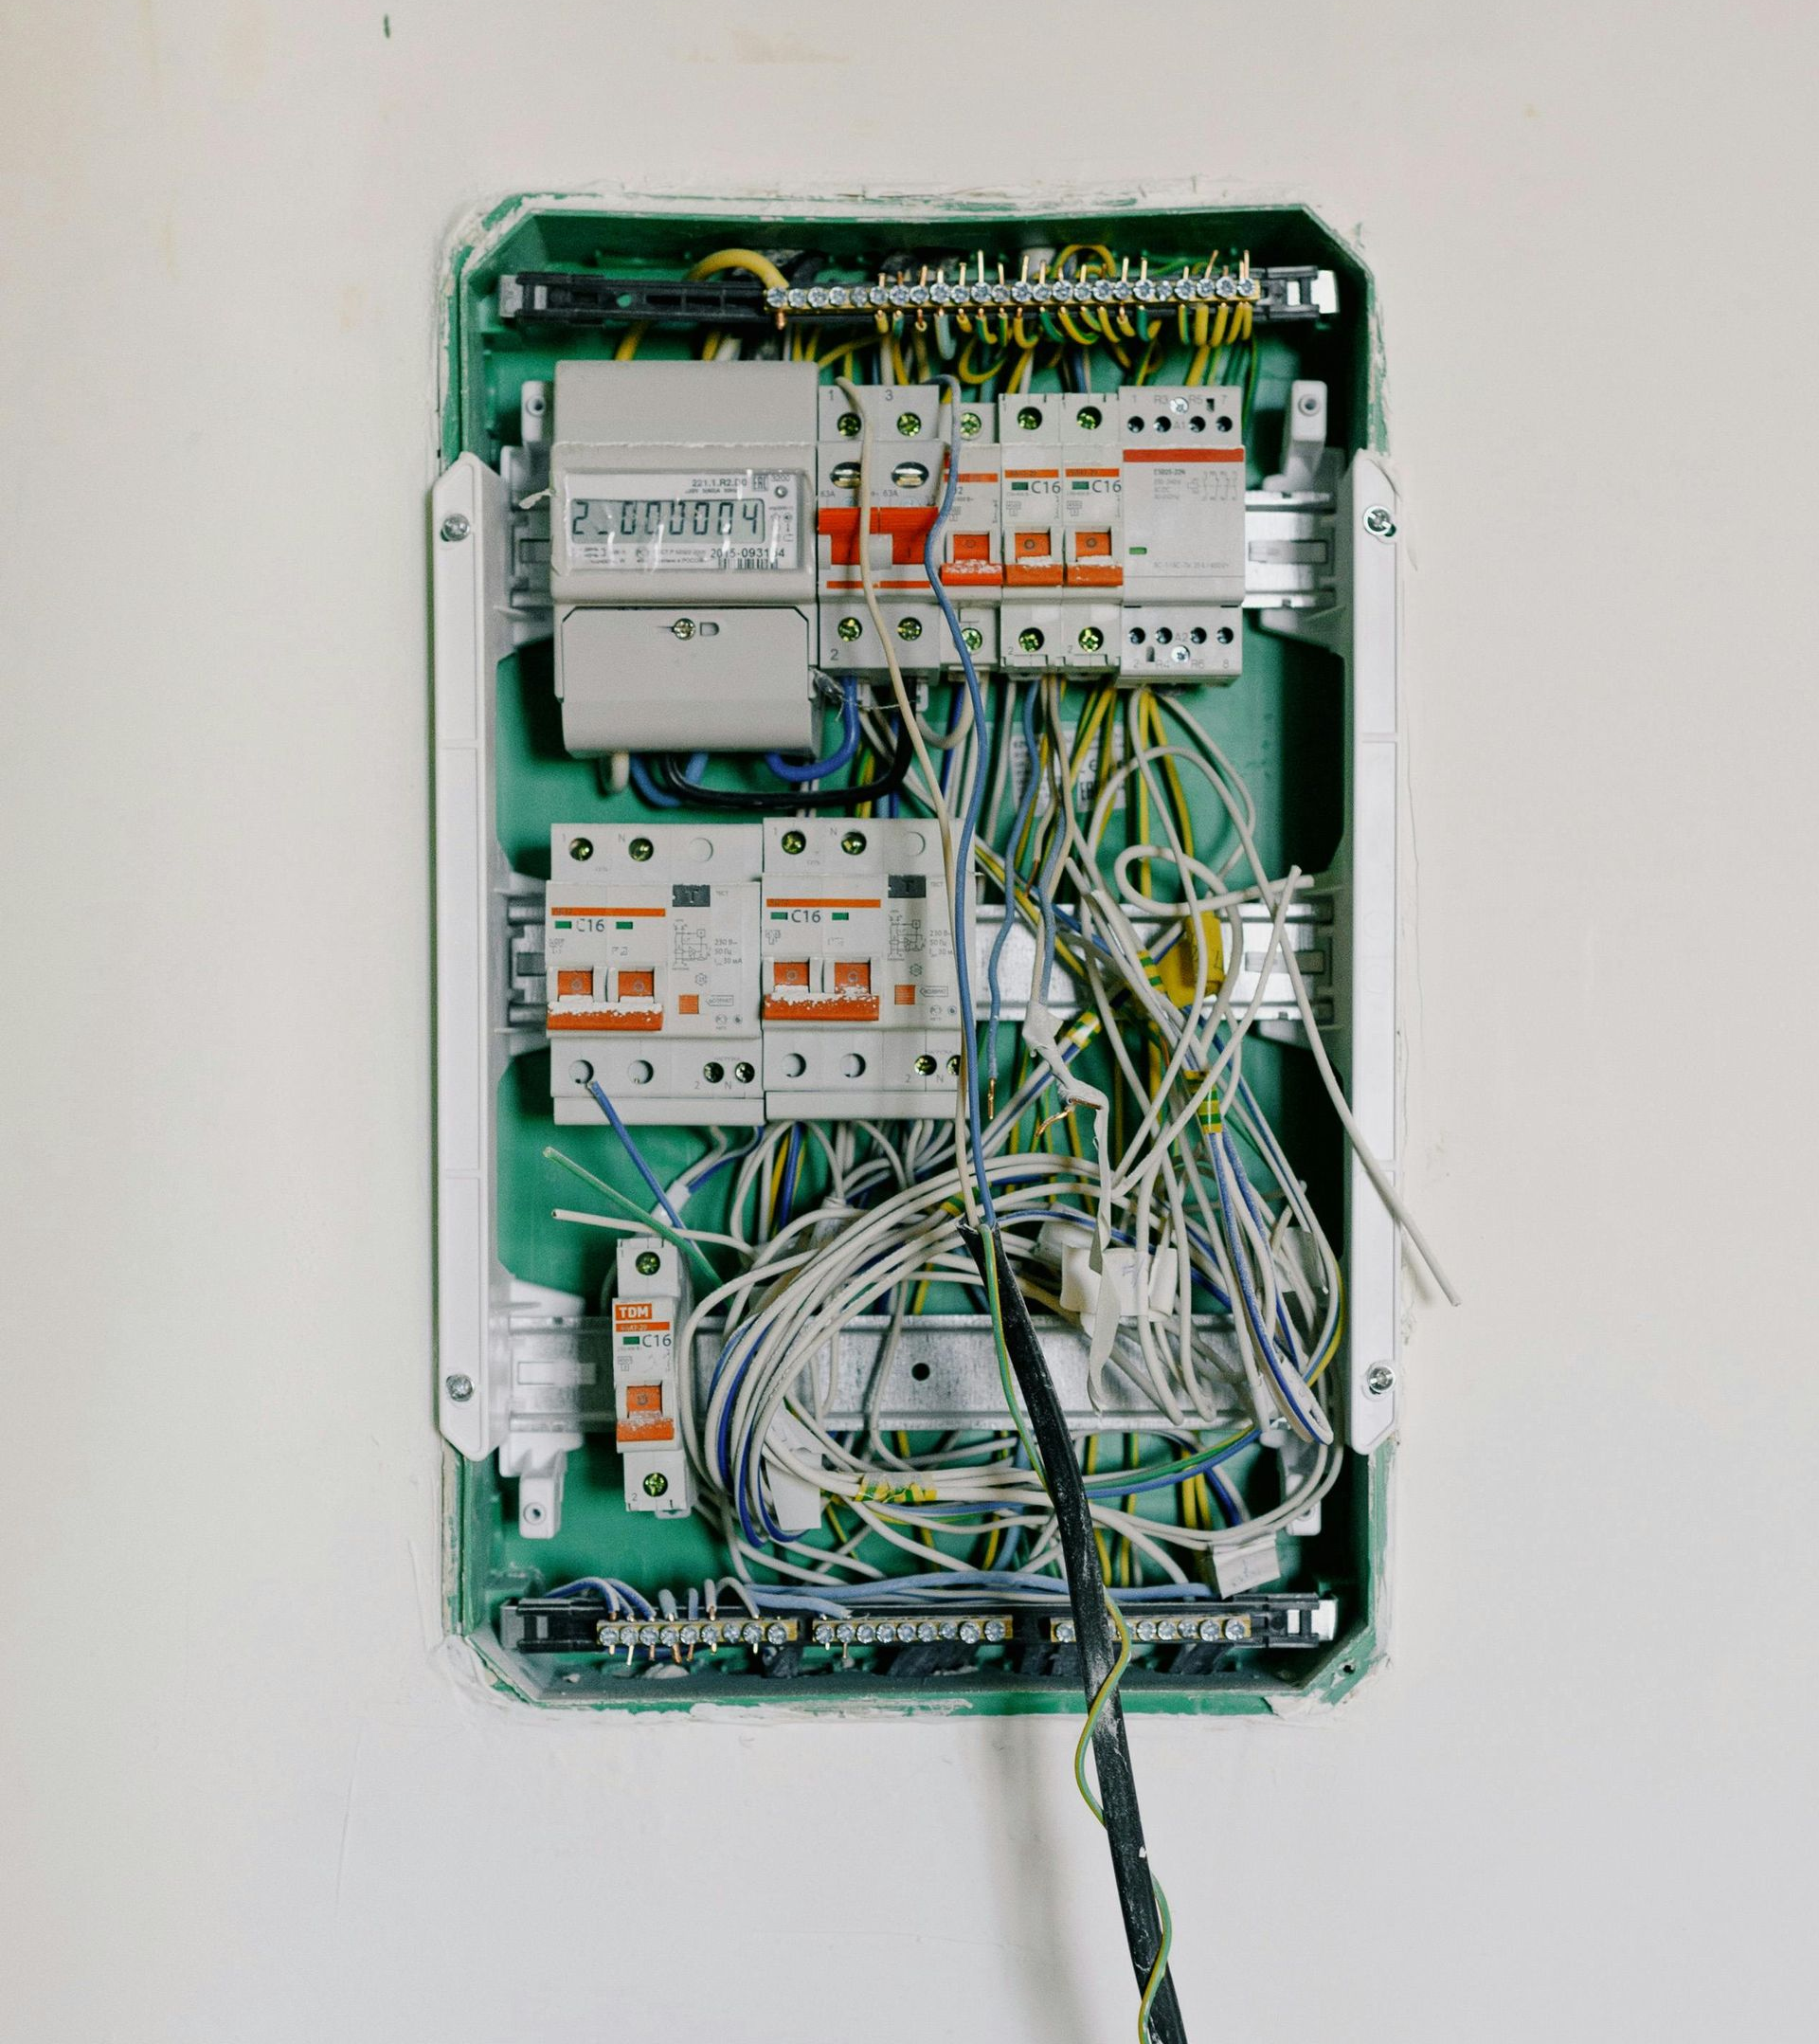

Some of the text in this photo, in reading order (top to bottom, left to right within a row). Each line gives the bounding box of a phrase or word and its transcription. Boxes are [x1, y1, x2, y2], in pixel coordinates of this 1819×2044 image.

[828, 389, 835, 401] 1
[885, 389, 893, 401] 3
[1031, 480, 1061, 494] C16
[1091, 479, 1122, 493] C16
[1175, 632, 1188, 642] A2
[830, 648, 839, 661] 2
[1008, 646, 1014, 656] 2
[1223, 659, 1230, 669] 8
[619, 833, 626, 842] N
[791, 910, 821, 923] C16
[576, 918, 605, 932] C16
[905, 1074, 911, 1083] 2
[936, 1074, 944, 1083] N
[694, 1080, 700, 1090] 2
[724, 1080, 732, 1090] N
[618, 1306, 649, 1319] TDM
[642, 1334, 672, 1348] C16
[630, 1492, 638, 1502] 2
